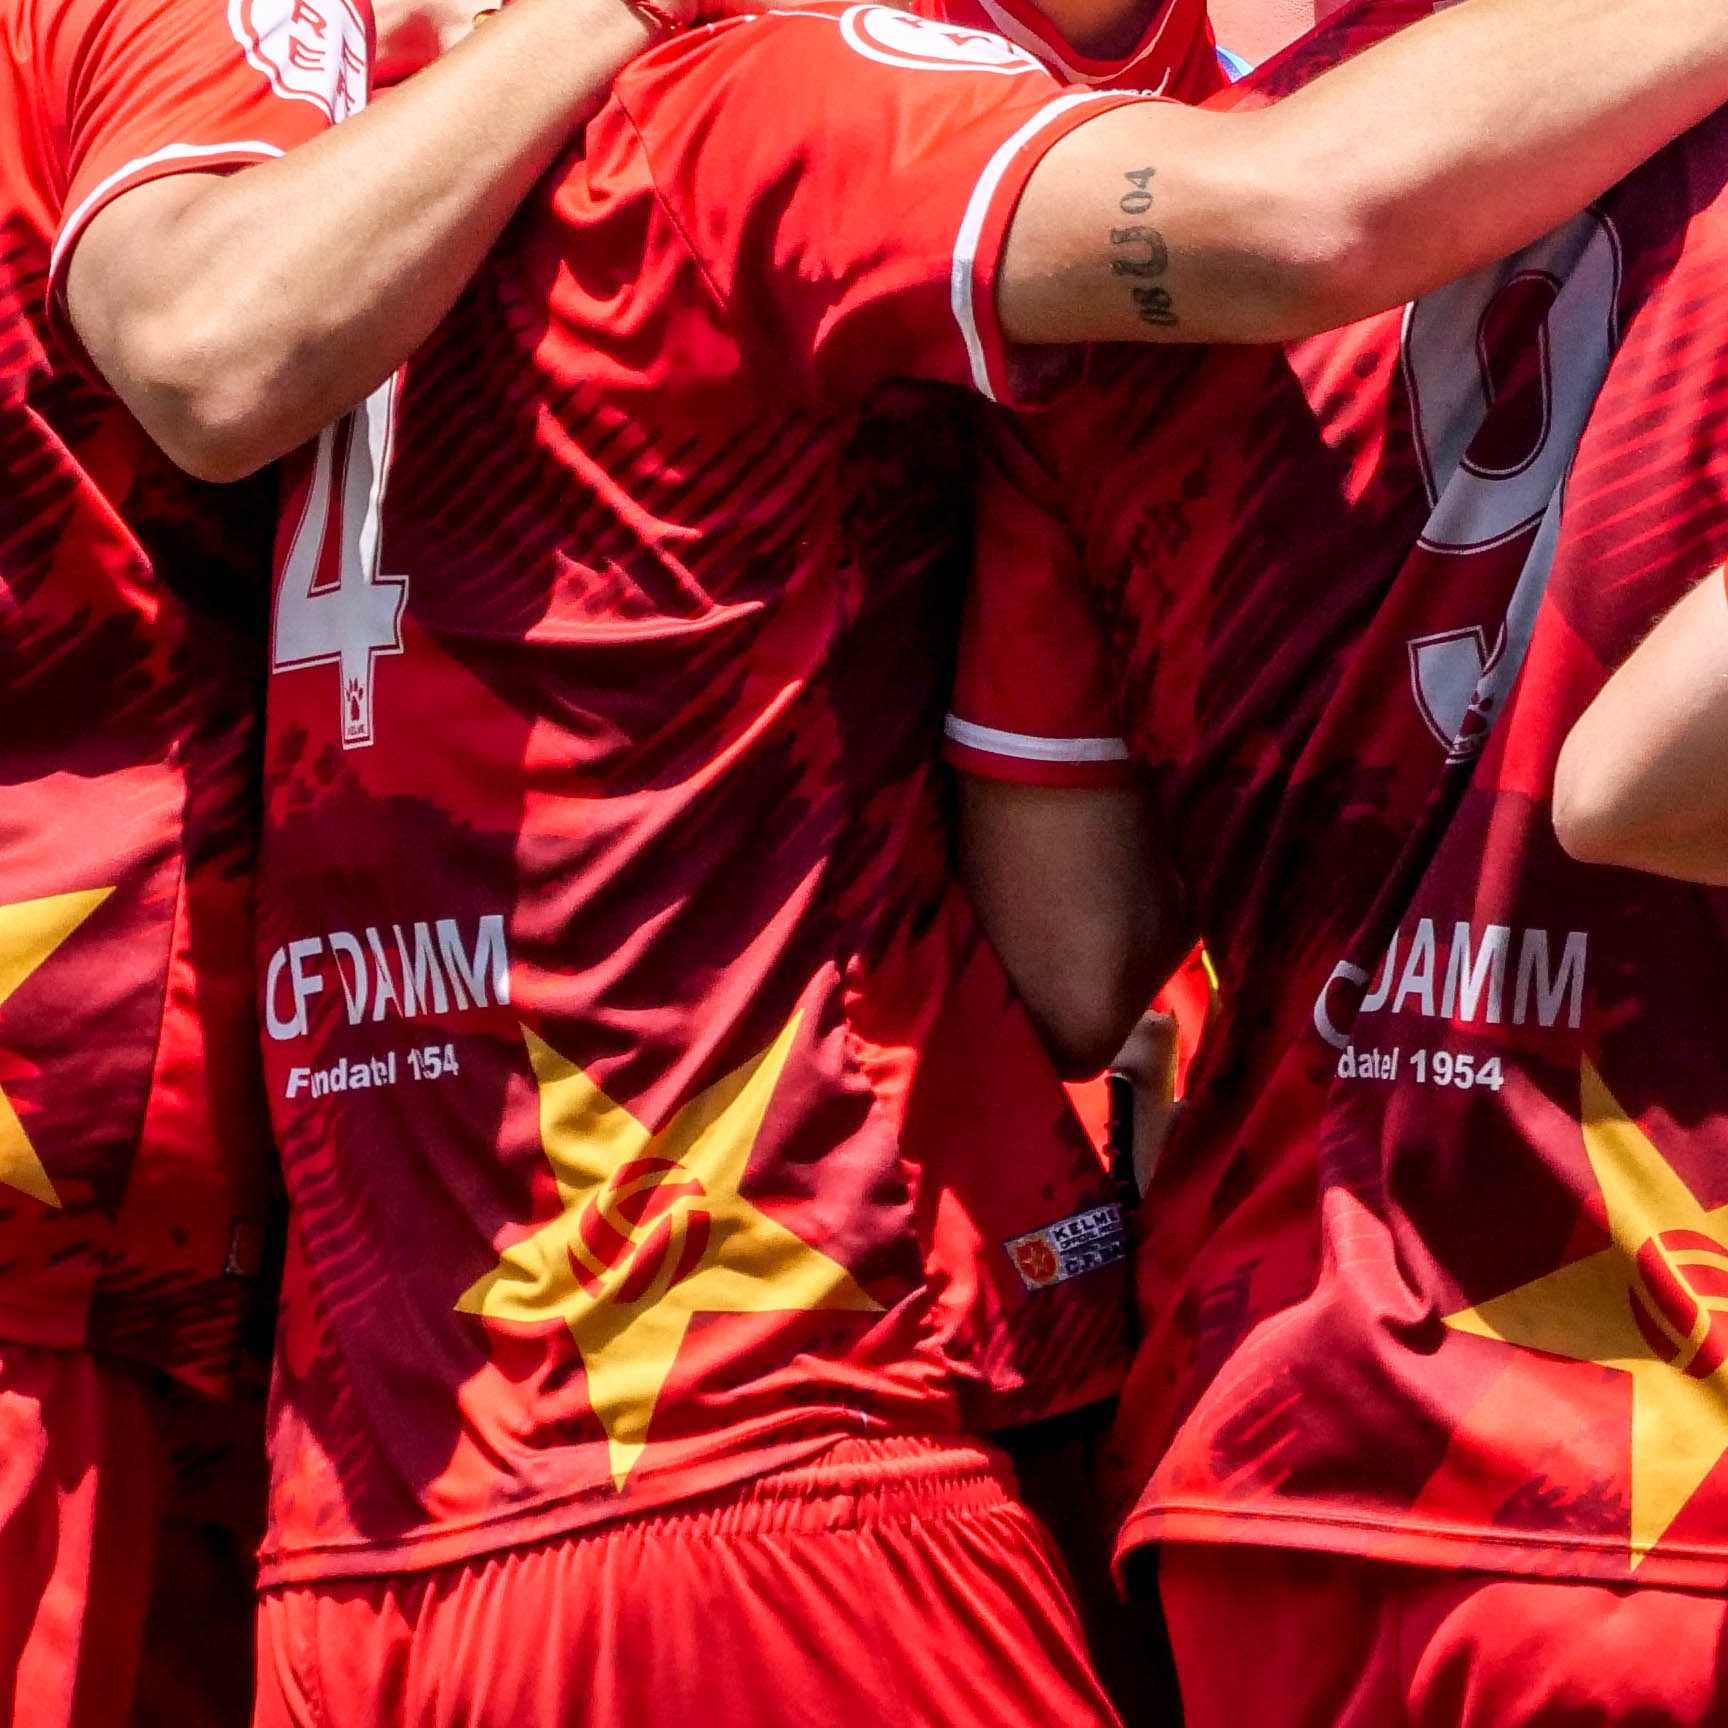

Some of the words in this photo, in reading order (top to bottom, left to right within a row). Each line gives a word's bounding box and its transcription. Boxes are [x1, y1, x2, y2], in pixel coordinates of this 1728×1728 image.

[273, 370, 409, 750] 4
[266, 936, 323, 1041] CF
[1410, 1048, 1505, 1091] 1954
